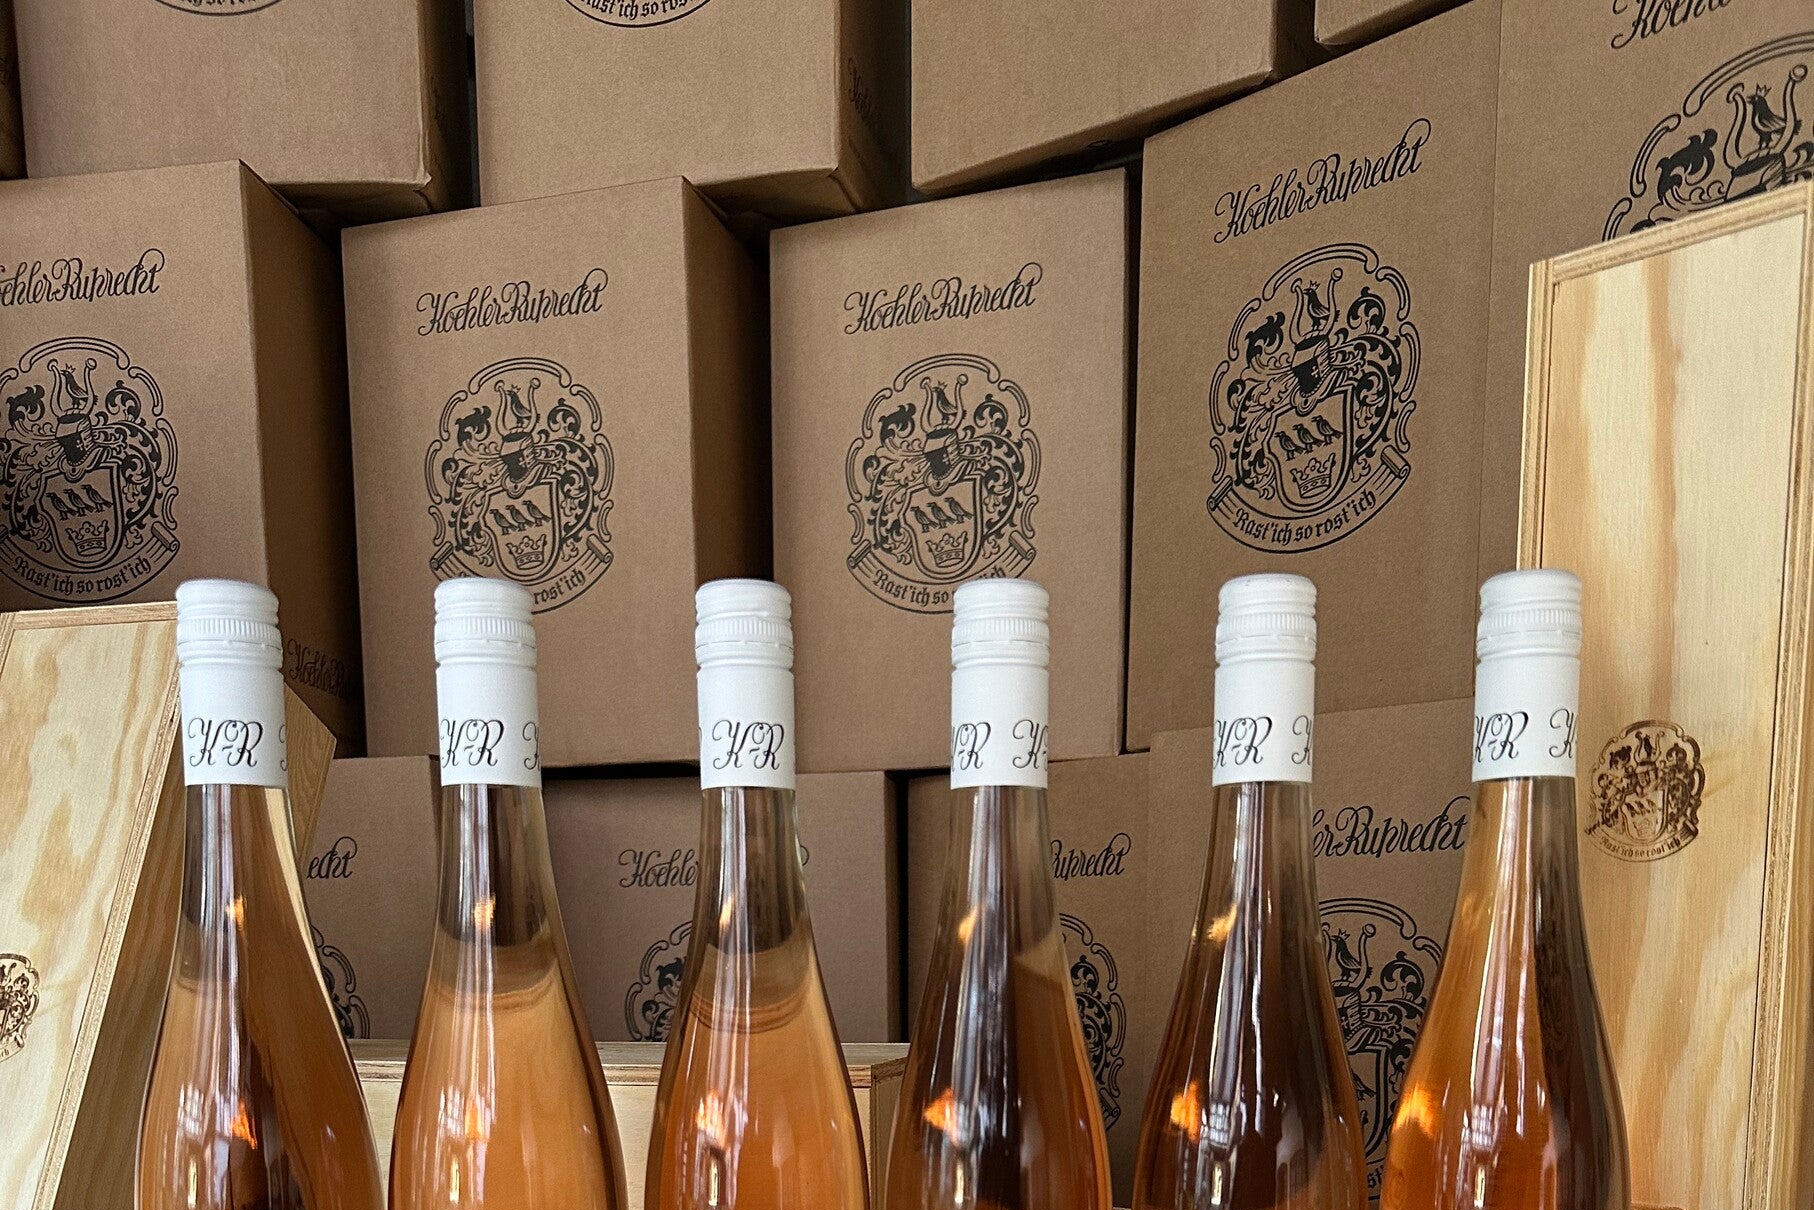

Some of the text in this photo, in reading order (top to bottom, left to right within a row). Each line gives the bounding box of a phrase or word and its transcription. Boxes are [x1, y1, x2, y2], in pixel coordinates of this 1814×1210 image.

[1293, 526, 1313, 542] so
[76, 580, 94, 594] so
[931, 592, 949, 605] so
